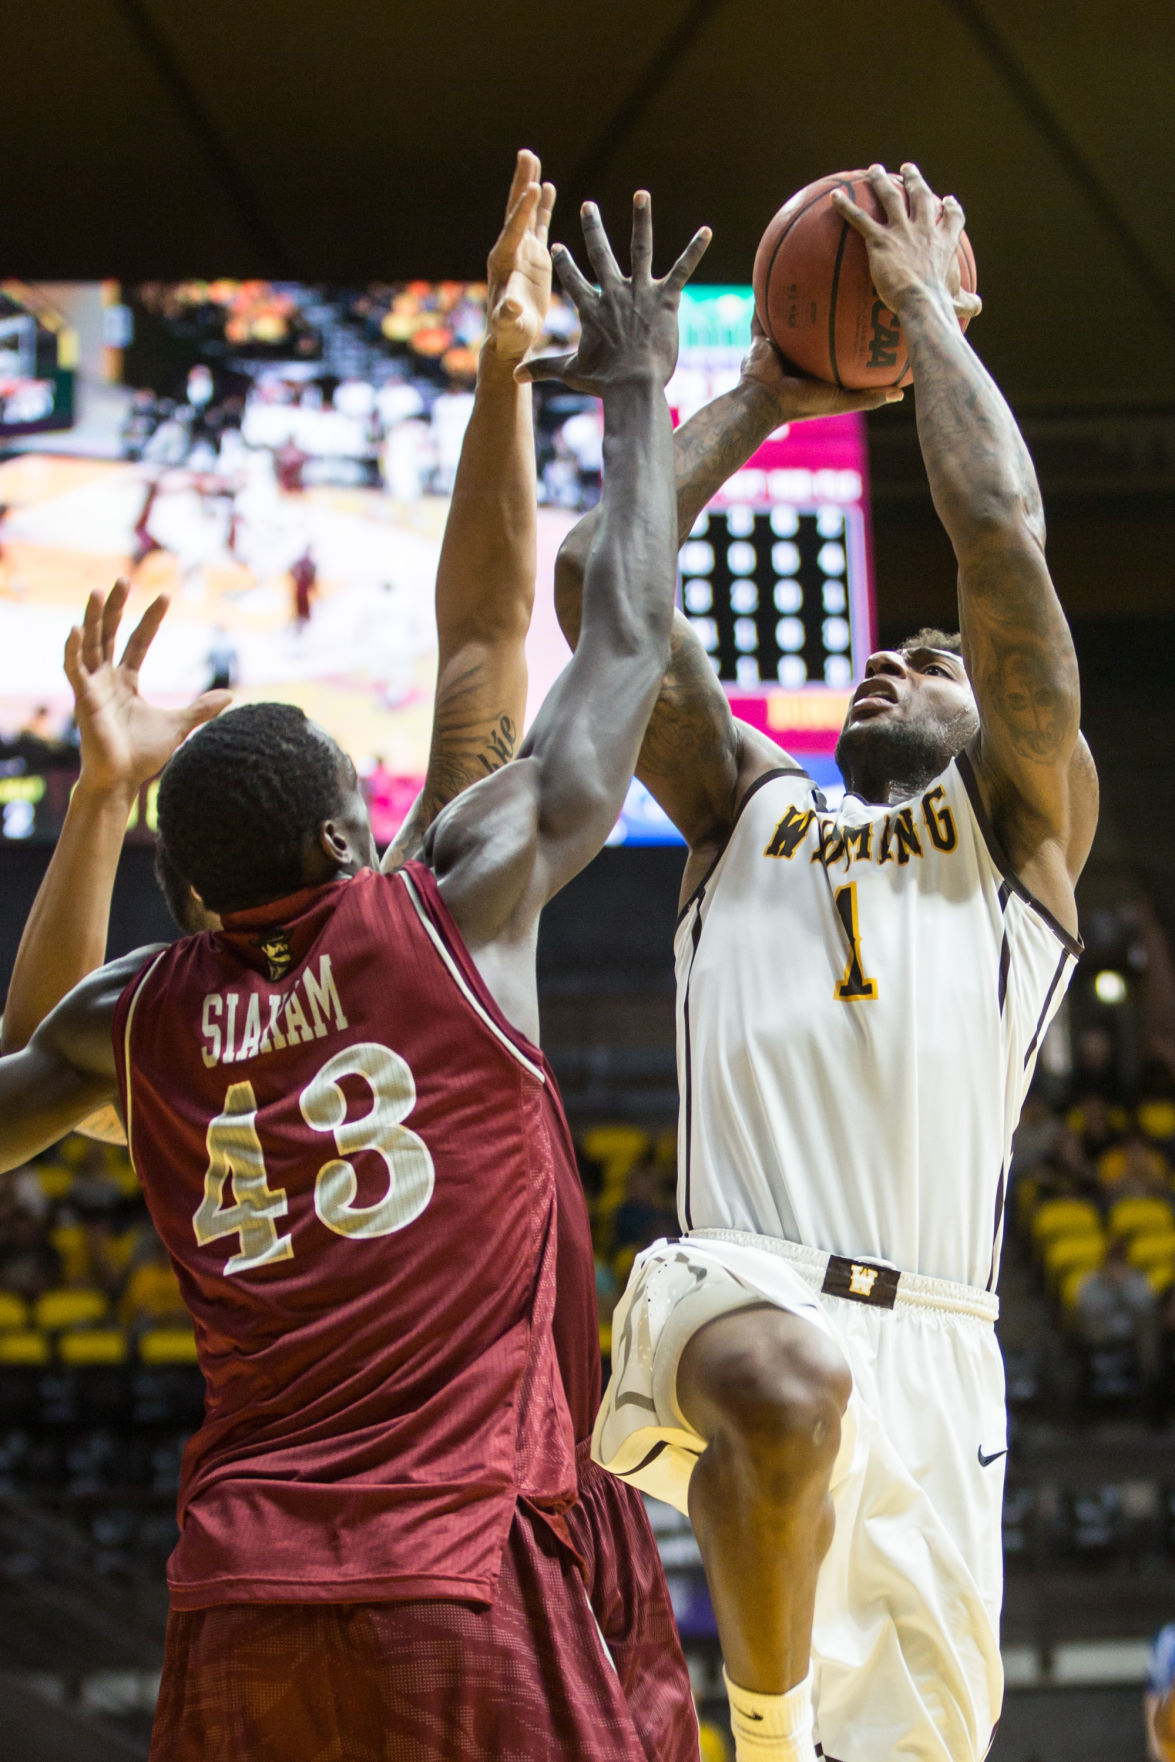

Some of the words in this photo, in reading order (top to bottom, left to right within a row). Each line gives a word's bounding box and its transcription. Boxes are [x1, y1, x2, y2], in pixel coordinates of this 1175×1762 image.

[867, 286, 900, 368] CAA
[833, 881, 878, 1001] 1
[201, 954, 349, 1069] SIAKAM
[193, 1042, 435, 1276] 43
